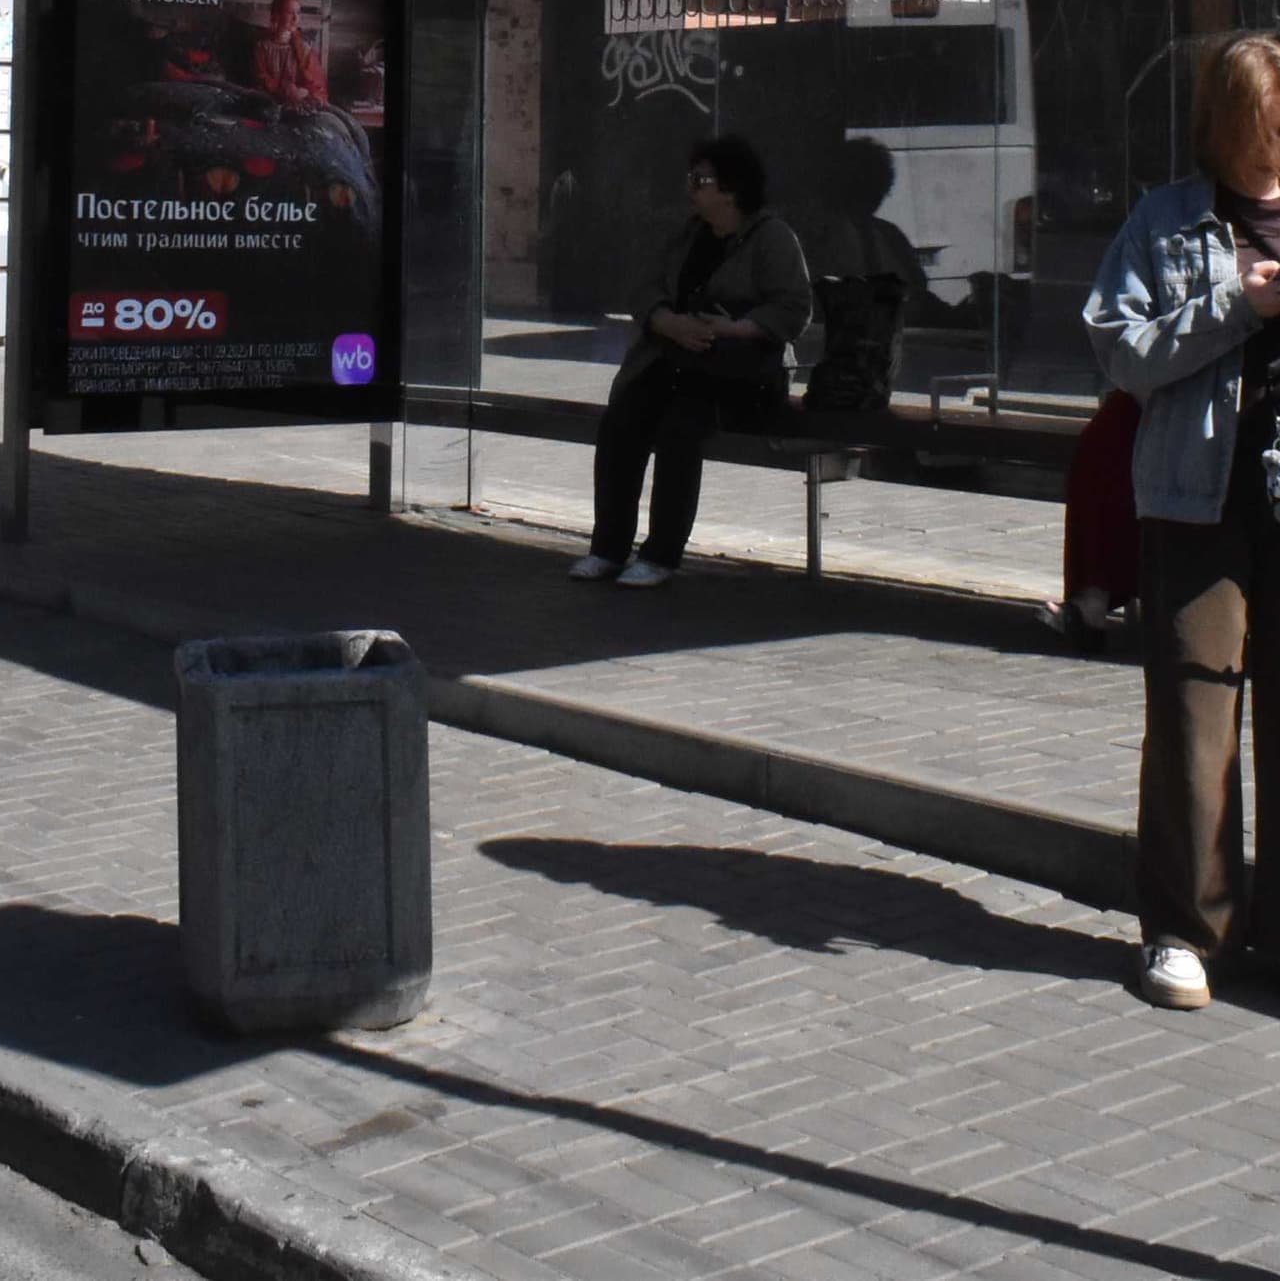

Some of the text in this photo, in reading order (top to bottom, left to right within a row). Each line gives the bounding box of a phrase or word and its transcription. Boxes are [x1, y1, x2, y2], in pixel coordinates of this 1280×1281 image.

[76, 193, 318, 222] Постельное белье
[77, 231, 303, 252] чтим традиции вместе
[82, 302, 105, 315] до
[335, 345, 372, 370] wb
